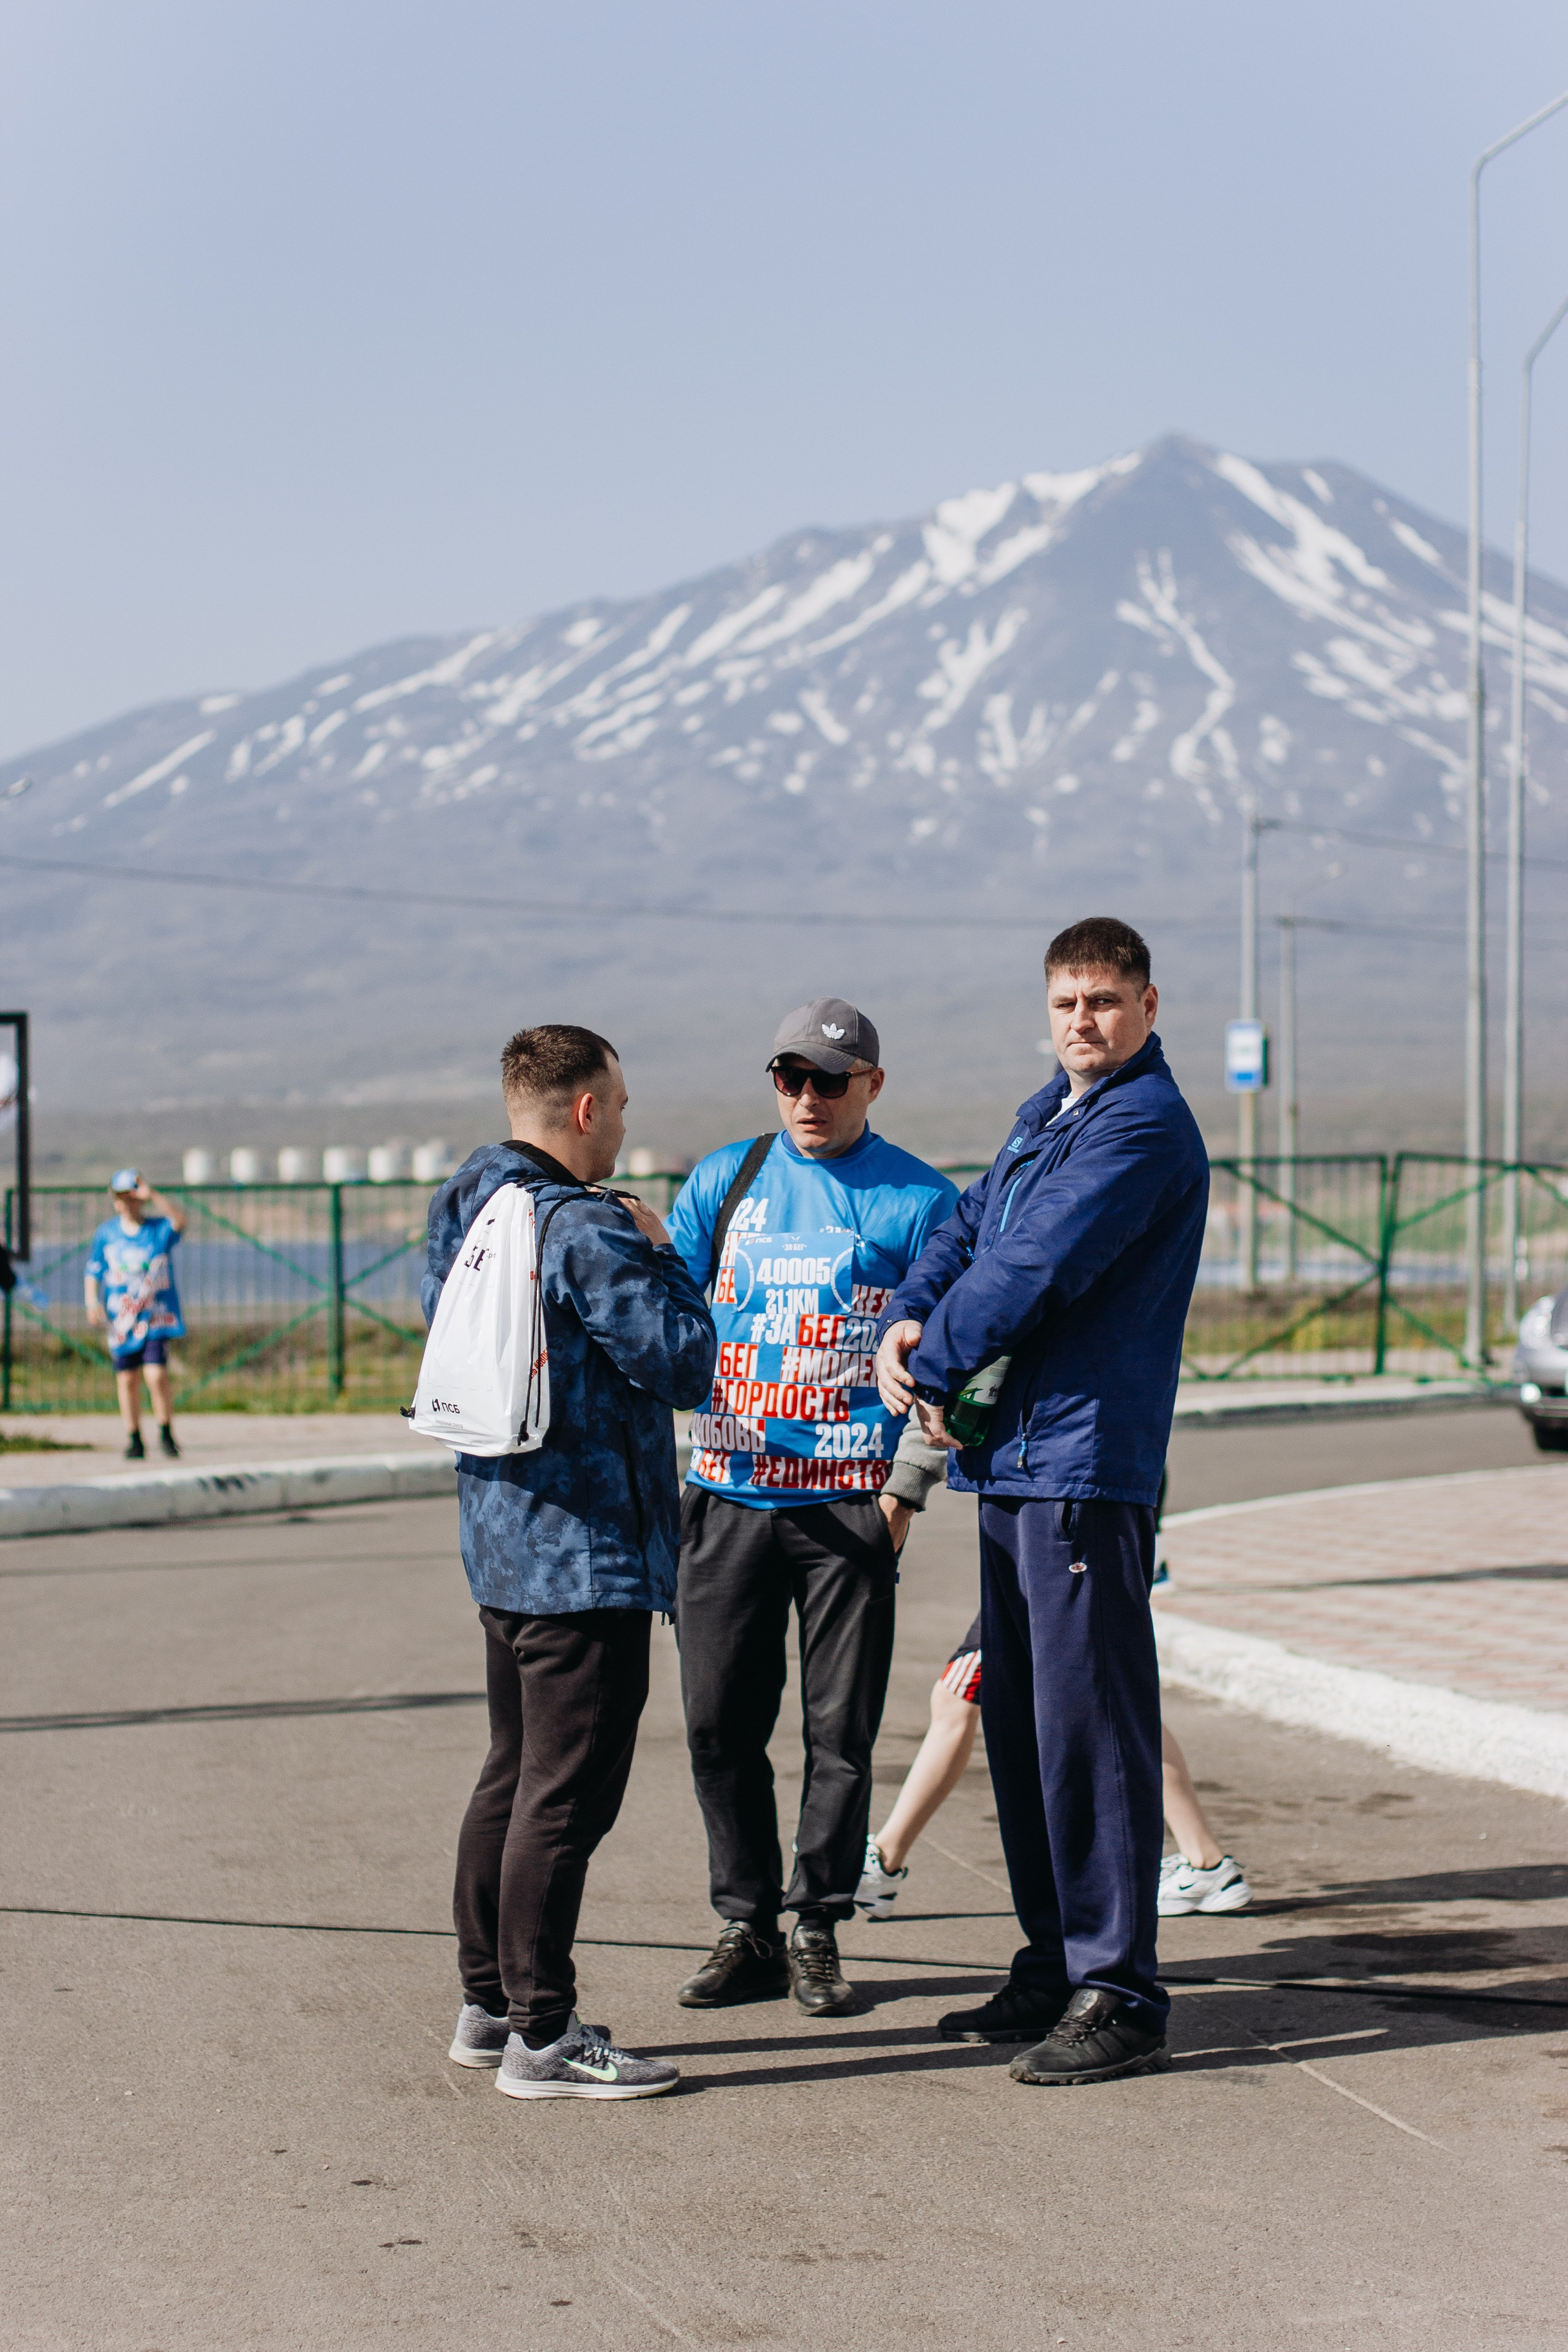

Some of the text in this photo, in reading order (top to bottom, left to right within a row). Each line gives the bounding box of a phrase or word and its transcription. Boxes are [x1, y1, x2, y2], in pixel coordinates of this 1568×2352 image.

[756, 1257, 831, 1285] 40005
[715, 1341, 759, 1379] БЕГ
[780, 1346, 878, 1387] #МОМЕ
[442, 1402, 460, 1414] ПСБ
[712, 1378, 850, 1422] #ГОРДОСТЬ
[814, 1422, 884, 1458] 2024
